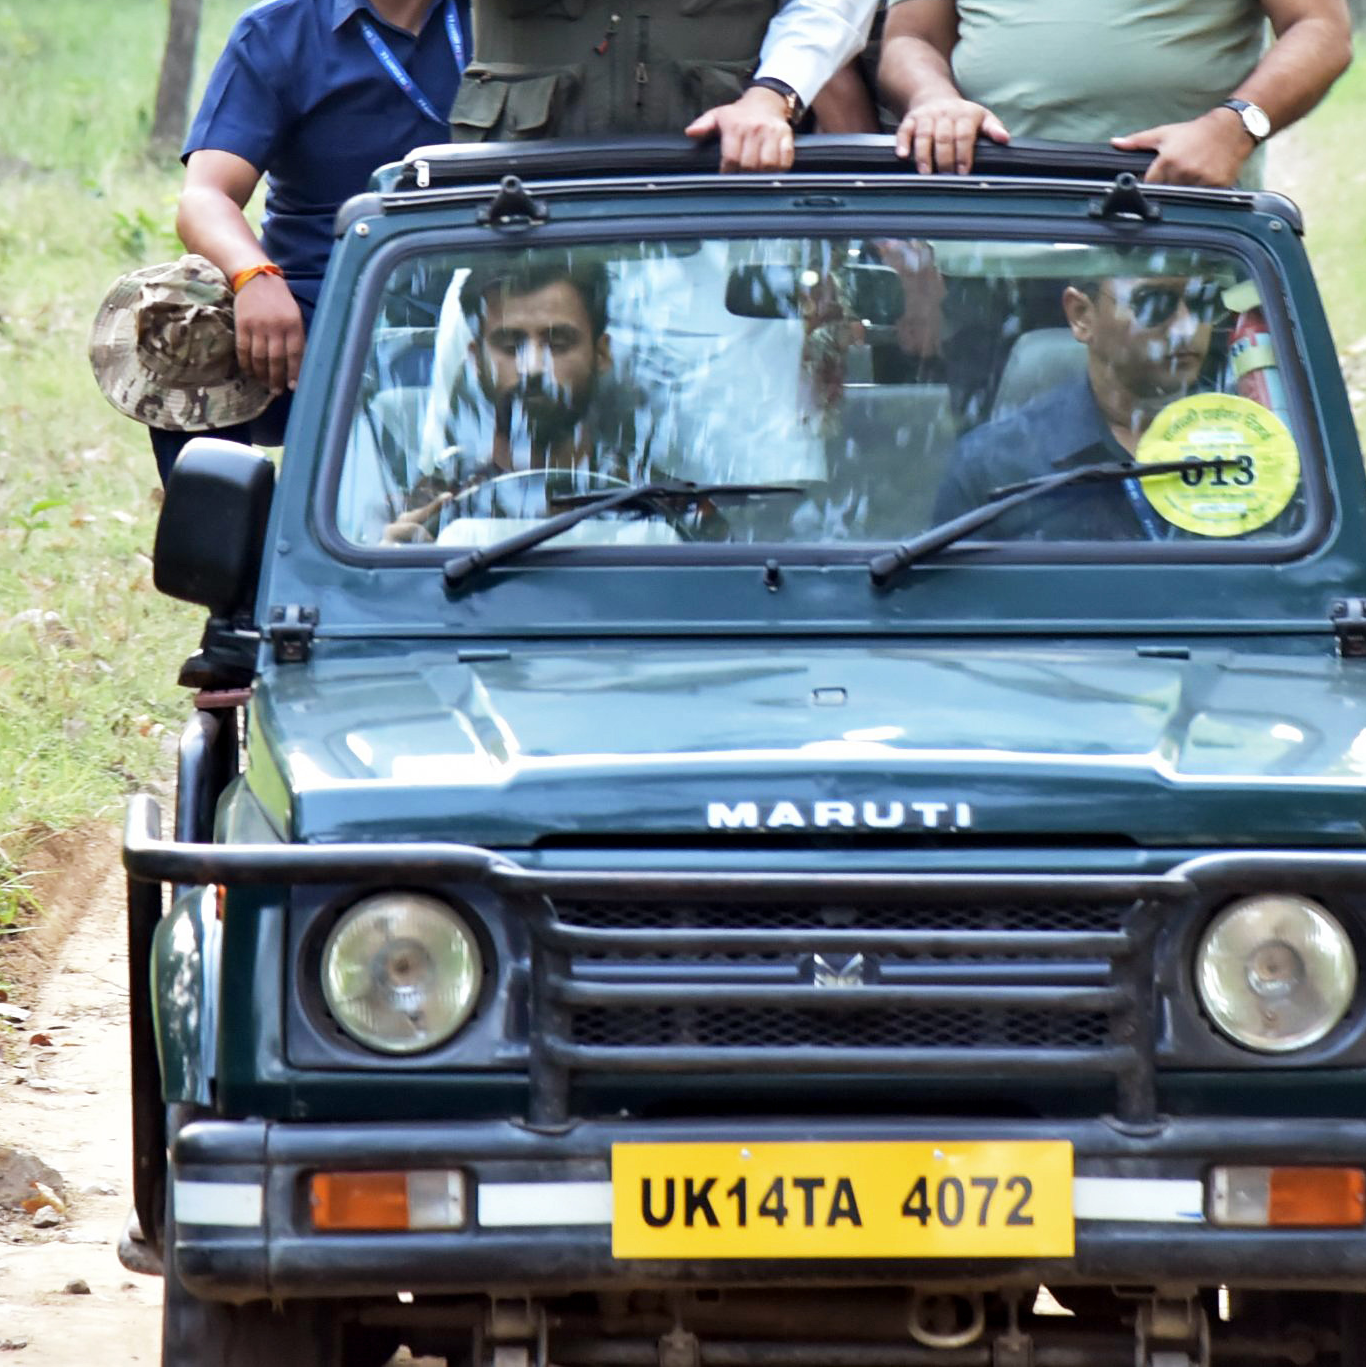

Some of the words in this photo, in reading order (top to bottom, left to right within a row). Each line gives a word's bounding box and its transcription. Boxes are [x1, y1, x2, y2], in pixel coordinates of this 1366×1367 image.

[1180, 455, 1254, 485] 013
[707, 801, 971, 828] MARUTI
[641, 1176, 862, 1228] UK14TA
[901, 1176, 1034, 1227] 4072
